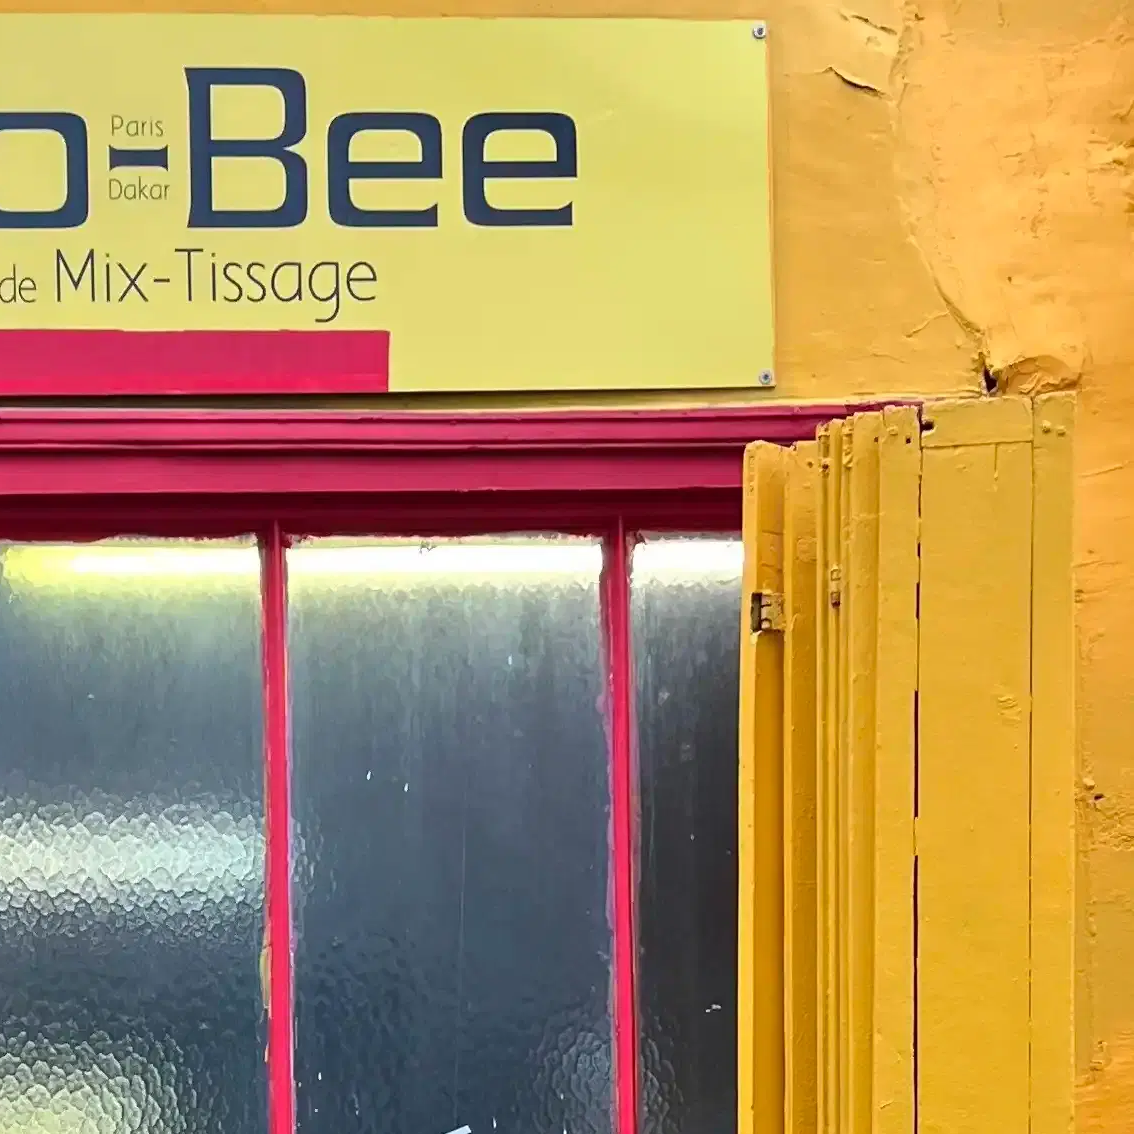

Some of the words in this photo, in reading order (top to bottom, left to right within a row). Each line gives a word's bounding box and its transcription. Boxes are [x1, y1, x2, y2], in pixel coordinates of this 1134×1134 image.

[110, 114, 164, 137] Paris
[108, 176, 170, 202] Dakar
[55, 247, 378, 323] Mix-Tissage
